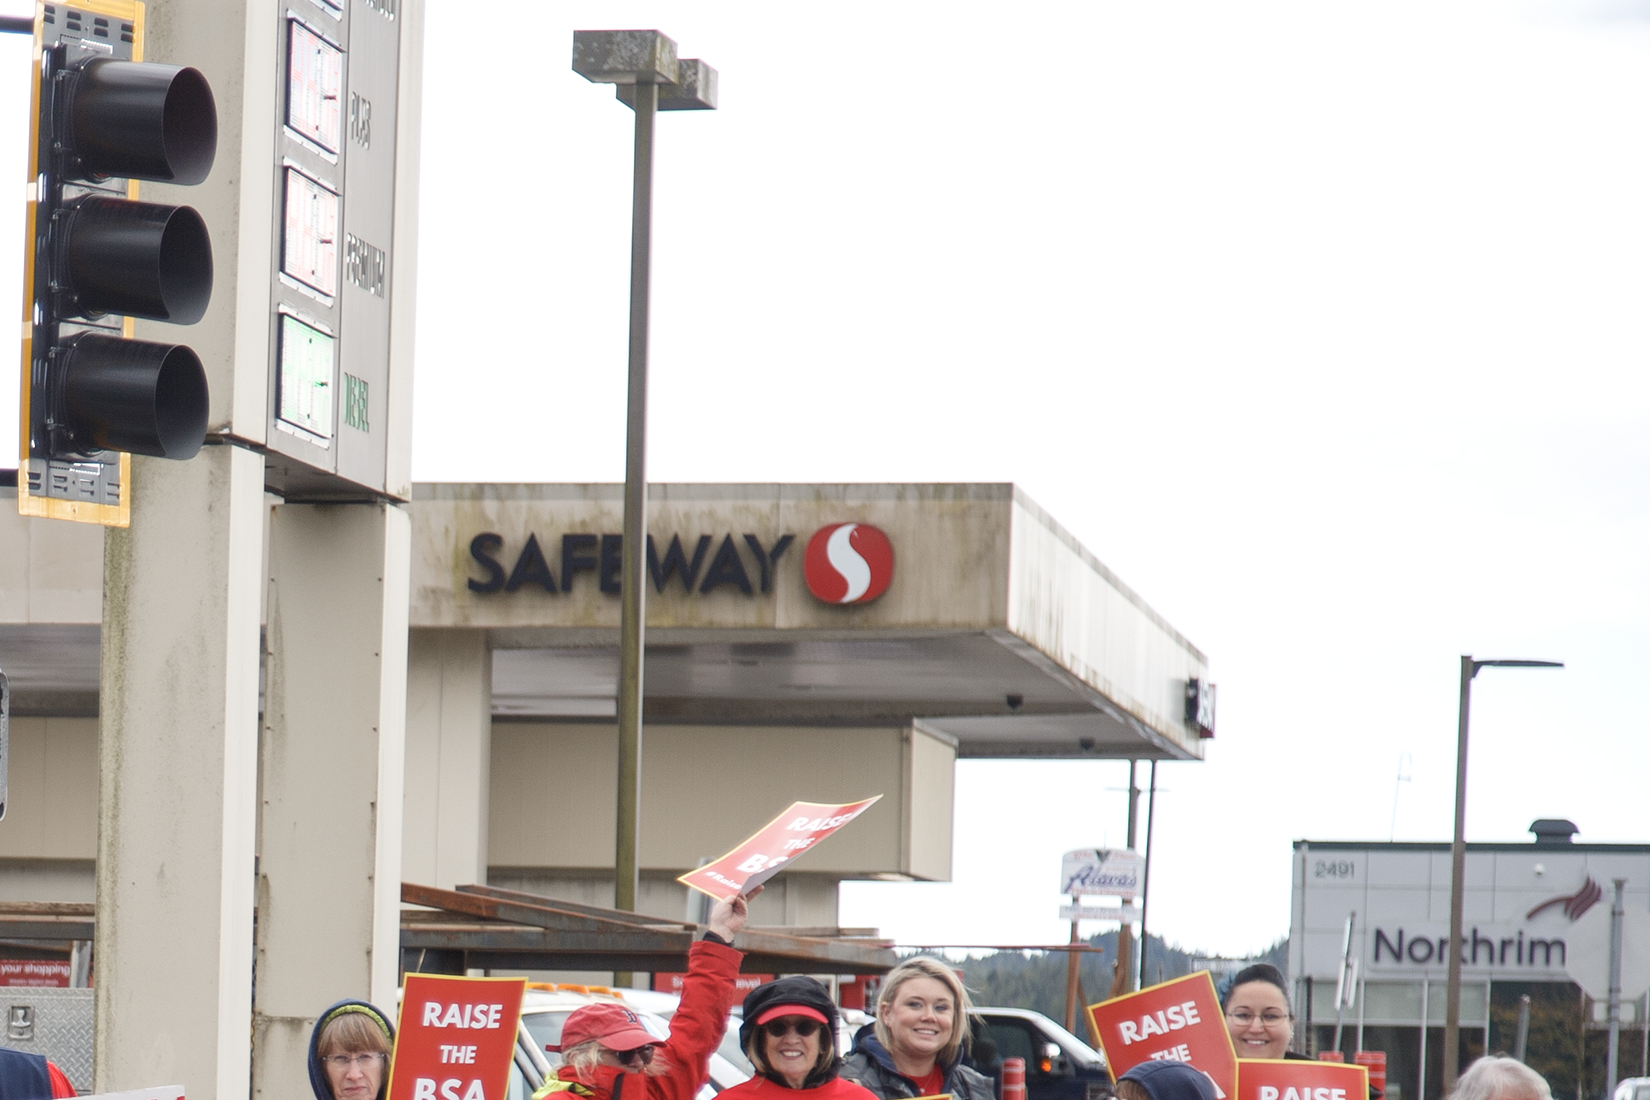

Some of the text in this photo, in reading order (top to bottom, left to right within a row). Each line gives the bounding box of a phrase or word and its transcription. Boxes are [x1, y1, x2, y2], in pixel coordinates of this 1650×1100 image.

[467, 531, 796, 595] SAFEWAY
[786, 812, 852, 831] RAISE
[783, 837, 815, 850] THE
[1314, 861, 1355, 878] 2491
[1, 964, 70, 978] your shopping
[422, 1001, 503, 1029] RAISE
[1119, 1000, 1201, 1045] RAISE
[440, 1045, 477, 1064] THE
